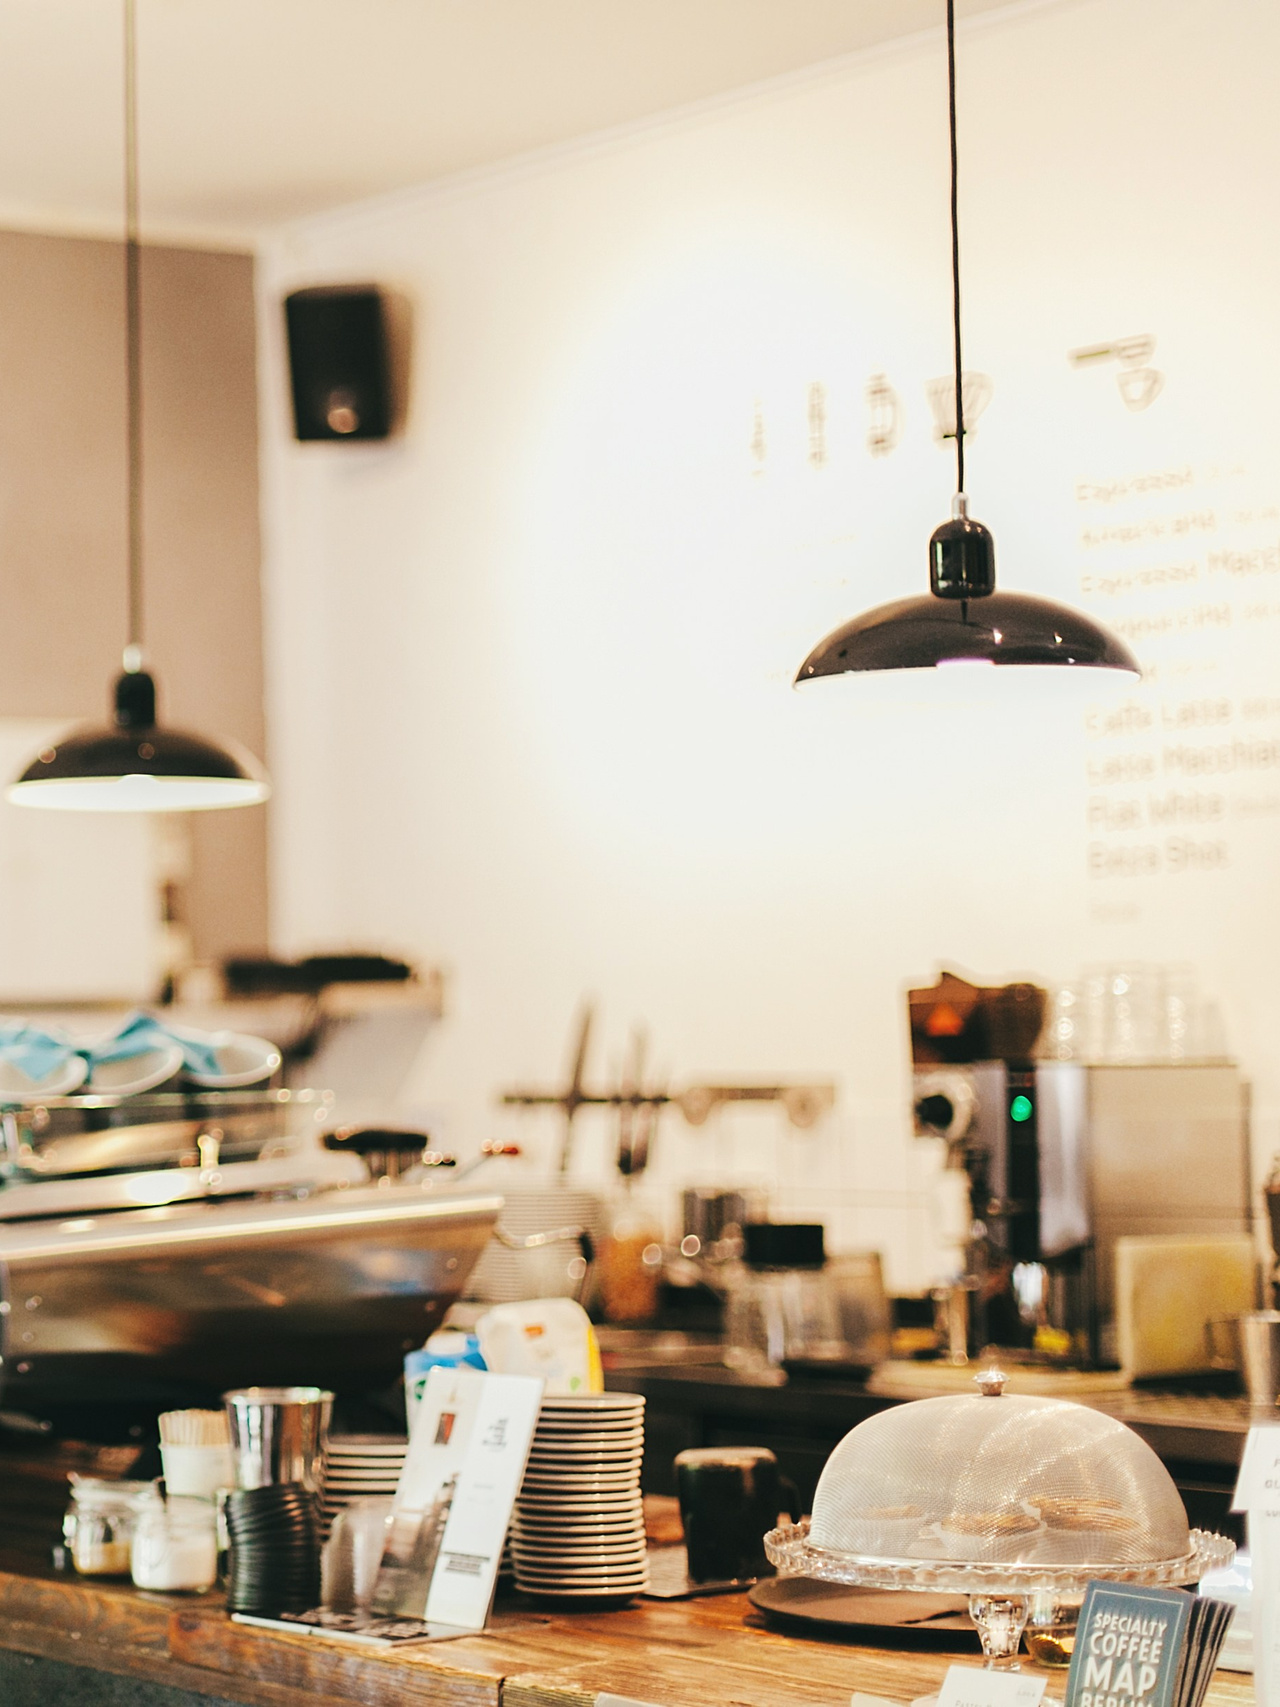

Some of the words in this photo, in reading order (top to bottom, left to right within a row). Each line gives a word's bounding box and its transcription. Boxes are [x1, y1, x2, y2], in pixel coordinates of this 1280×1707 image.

[1093, 1613, 1167, 1637] SPECIALTY
[1090, 1631, 1163, 1664] COFFEE
[1084, 1656, 1157, 1697] MAP
[1081, 1691, 1153, 1707] BER
